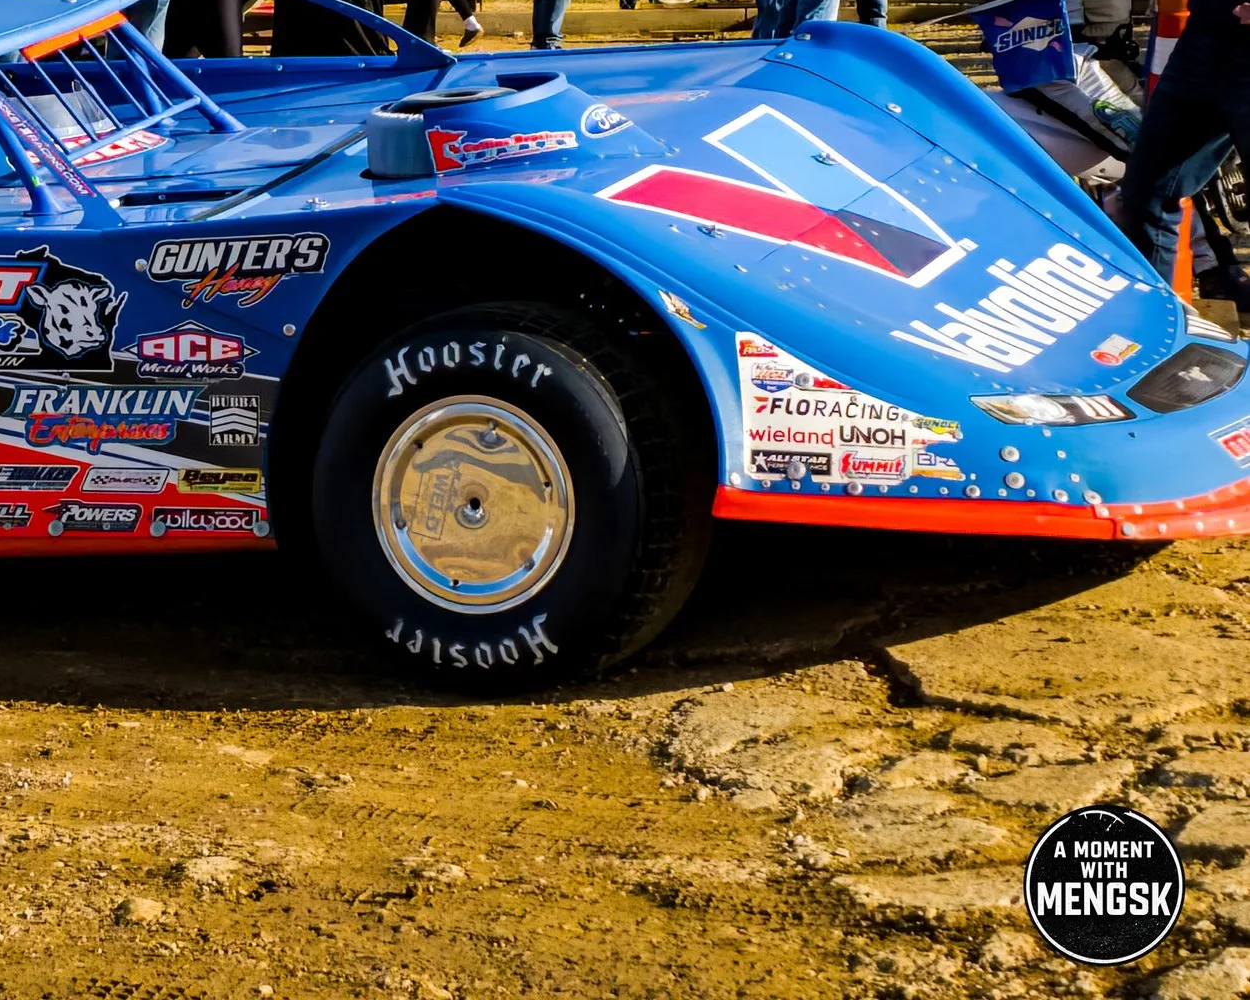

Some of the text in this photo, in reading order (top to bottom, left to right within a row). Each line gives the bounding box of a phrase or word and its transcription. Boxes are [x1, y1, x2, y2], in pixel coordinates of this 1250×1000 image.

[151, 237, 324, 274] GUNTER'S
[889, 242, 1130, 373] Valvoline
[142, 333, 240, 362] ACE
[140, 363, 239, 375] Metal Works
[383, 334, 554, 398] Hoosier
[14, 389, 195, 420] FRANKLIN
[211, 395, 258, 409] BUBBA
[212, 433, 258, 445] ARMY
[750, 424, 906, 448] wieland UNOH
[61, 504, 138, 522] POWERS
[155, 509, 257, 530] wilwood
[384, 612, 559, 669] Hoosier
